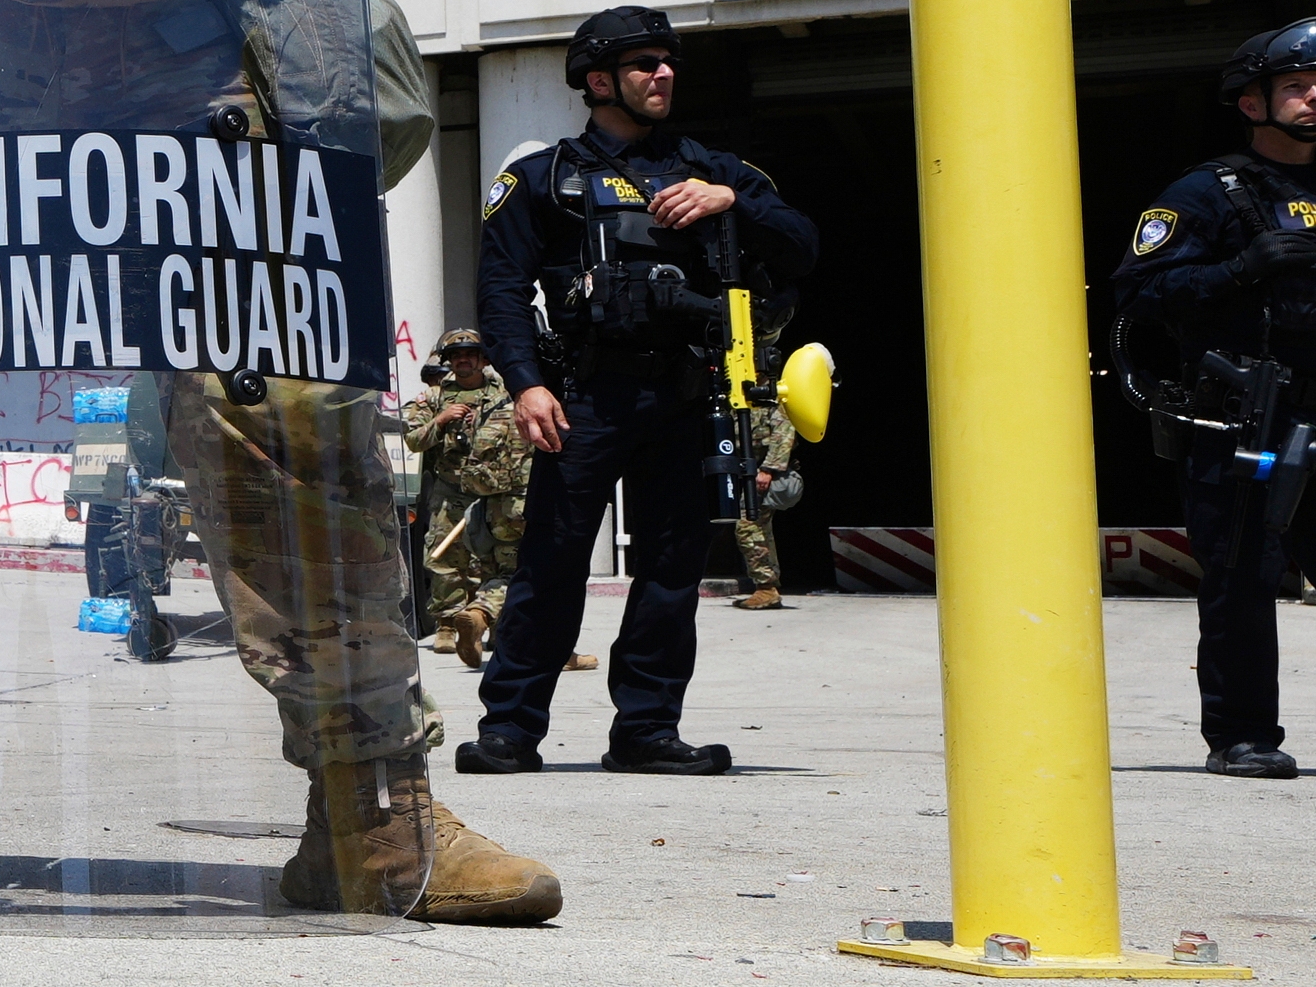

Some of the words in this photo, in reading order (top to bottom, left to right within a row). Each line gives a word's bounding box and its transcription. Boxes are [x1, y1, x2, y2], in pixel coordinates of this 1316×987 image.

[603, 177, 633, 187] POL
[1288, 201, 1316, 217] POL
[1145, 212, 1174, 223] POLICE
[159, 254, 350, 381] GUARD
